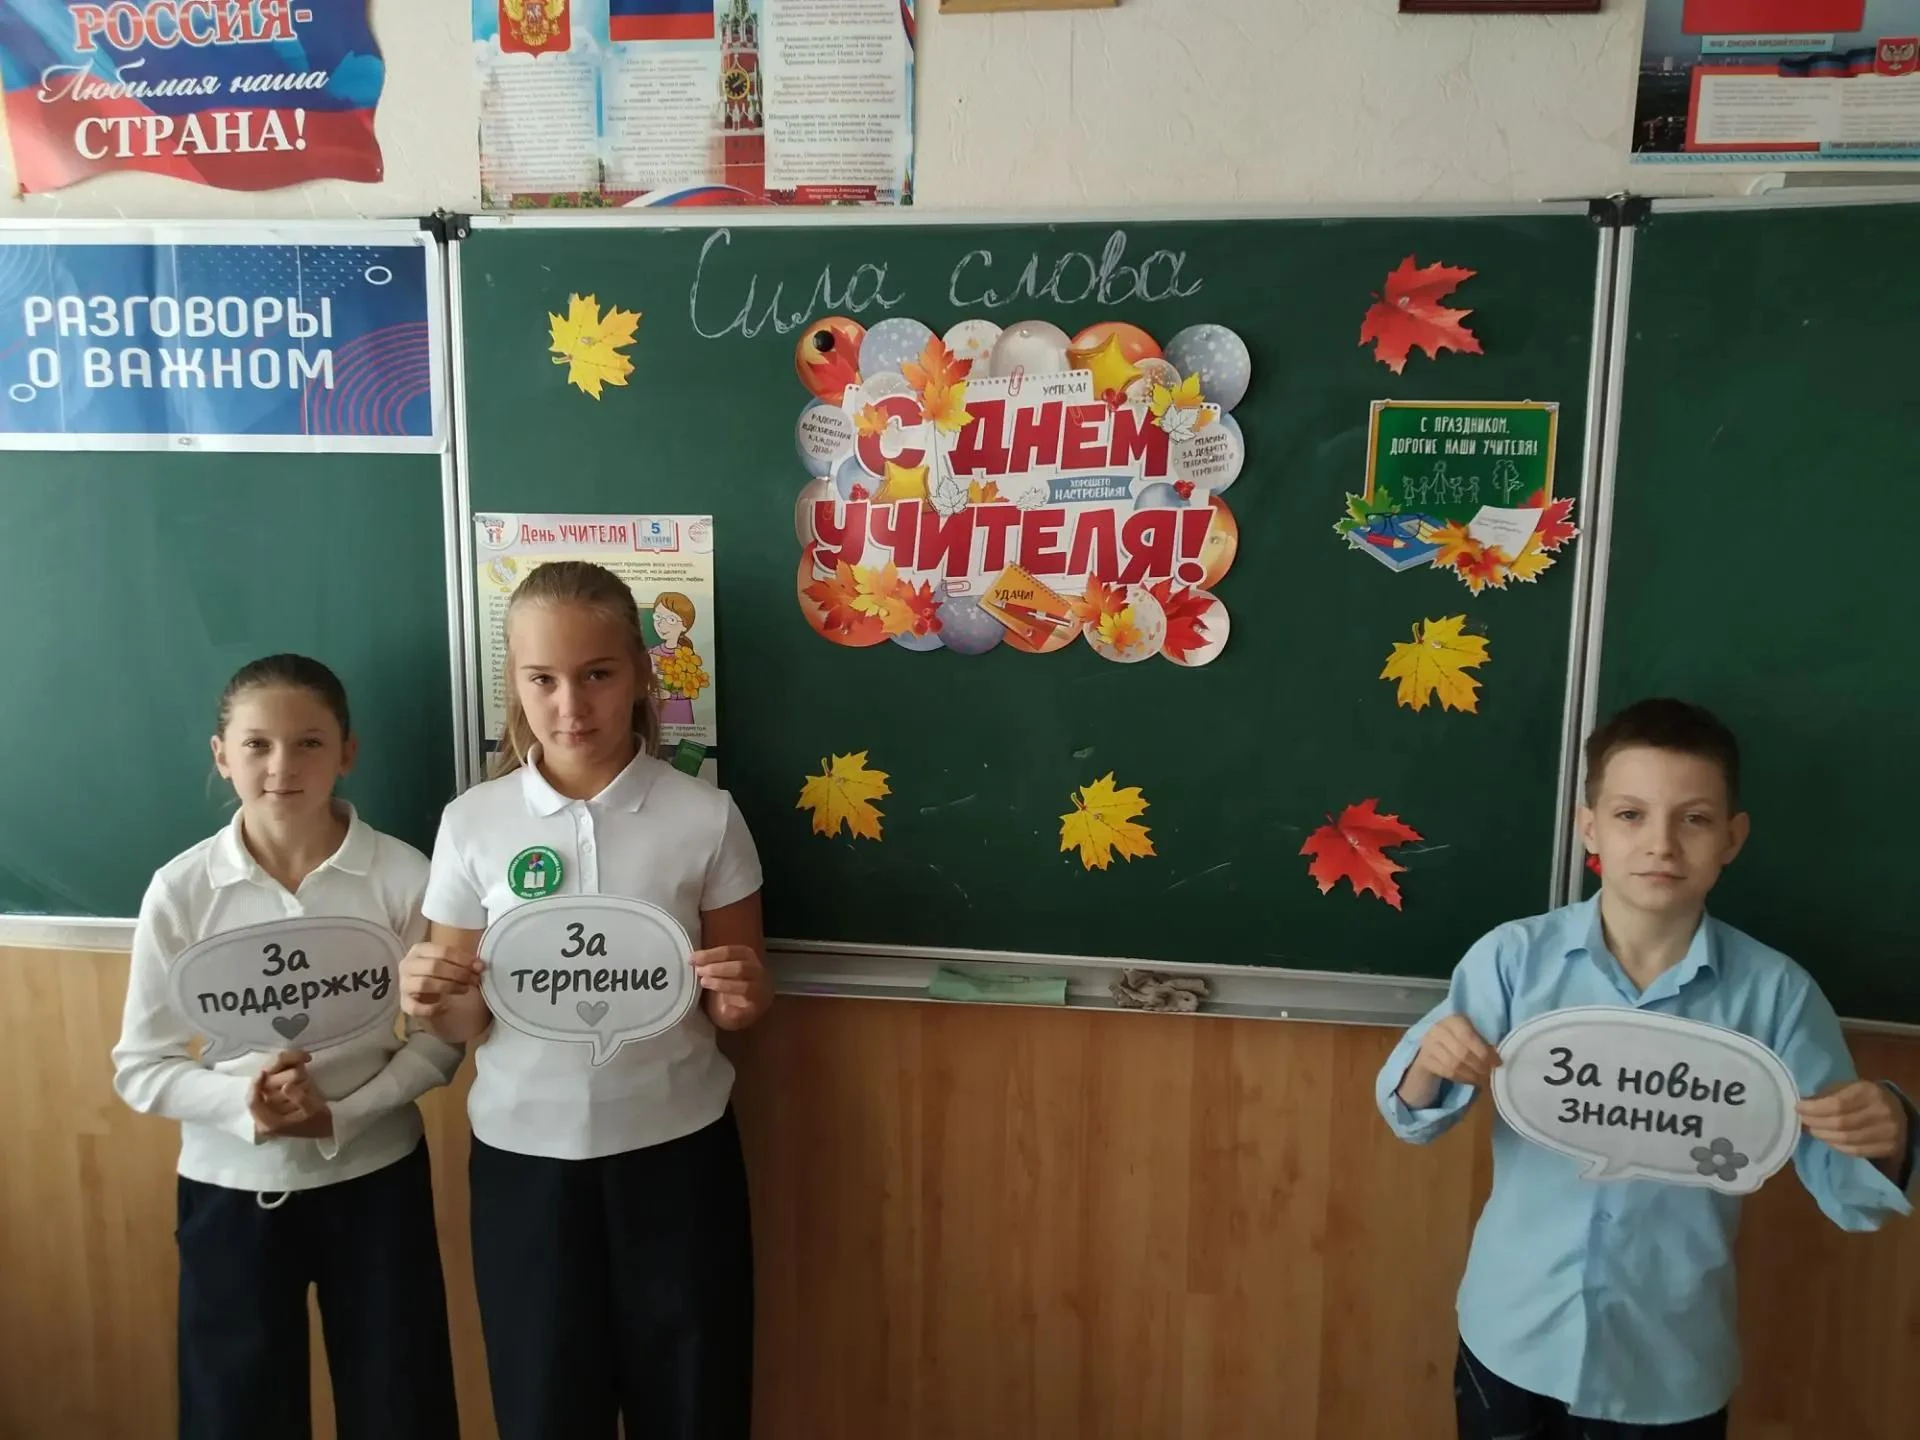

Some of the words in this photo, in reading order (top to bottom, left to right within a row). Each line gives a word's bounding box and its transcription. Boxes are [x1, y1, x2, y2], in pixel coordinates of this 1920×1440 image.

[69, 0, 313, 52] РОССИЯ-
[38, 58, 220, 102] Любимая
[229, 67, 330, 95] наша
[74, 108, 308, 159] СТРАНА!
[690, 227, 906, 339] Сила
[948, 229, 1203, 306] слова
[24, 296, 333, 338] РАЗГОВОРЫ
[29, 348, 60, 389] О
[84, 348, 334, 389] ВАЖНОМ
[1042, 382, 1087, 396] УСПЕХА!
[853, 394, 929, 473] С
[947, 398, 1170, 478] ДНЕМ
[1420, 416, 1428, 433] С
[1389, 437, 1438, 456] ДОРОГИЕ
[1444, 440, 1477, 455] НАШИ
[1483, 439, 1538, 456] УЧИТЕЛЯ!
[1055, 486, 1126, 500] НАСТРОЕНИЯ!
[1070, 478, 1111, 487] ХОРОШЕГО
[520, 524, 555, 545] День
[559, 524, 627, 545] УЧИТЕЛЯ
[651, 522, 661, 534] 5
[812, 498, 1217, 588] УЧИТЕЛЯ!
[994, 589, 1034, 601] УДАЧИ!
[262, 943, 310, 976] За
[560, 922, 608, 958] За
[197, 965, 392, 1017] поддержку
[510, 966, 669, 1005] терпение
[1543, 1047, 1602, 1086] За
[1617, 1062, 1747, 1106] новые
[1557, 1098, 1704, 1138] знания
